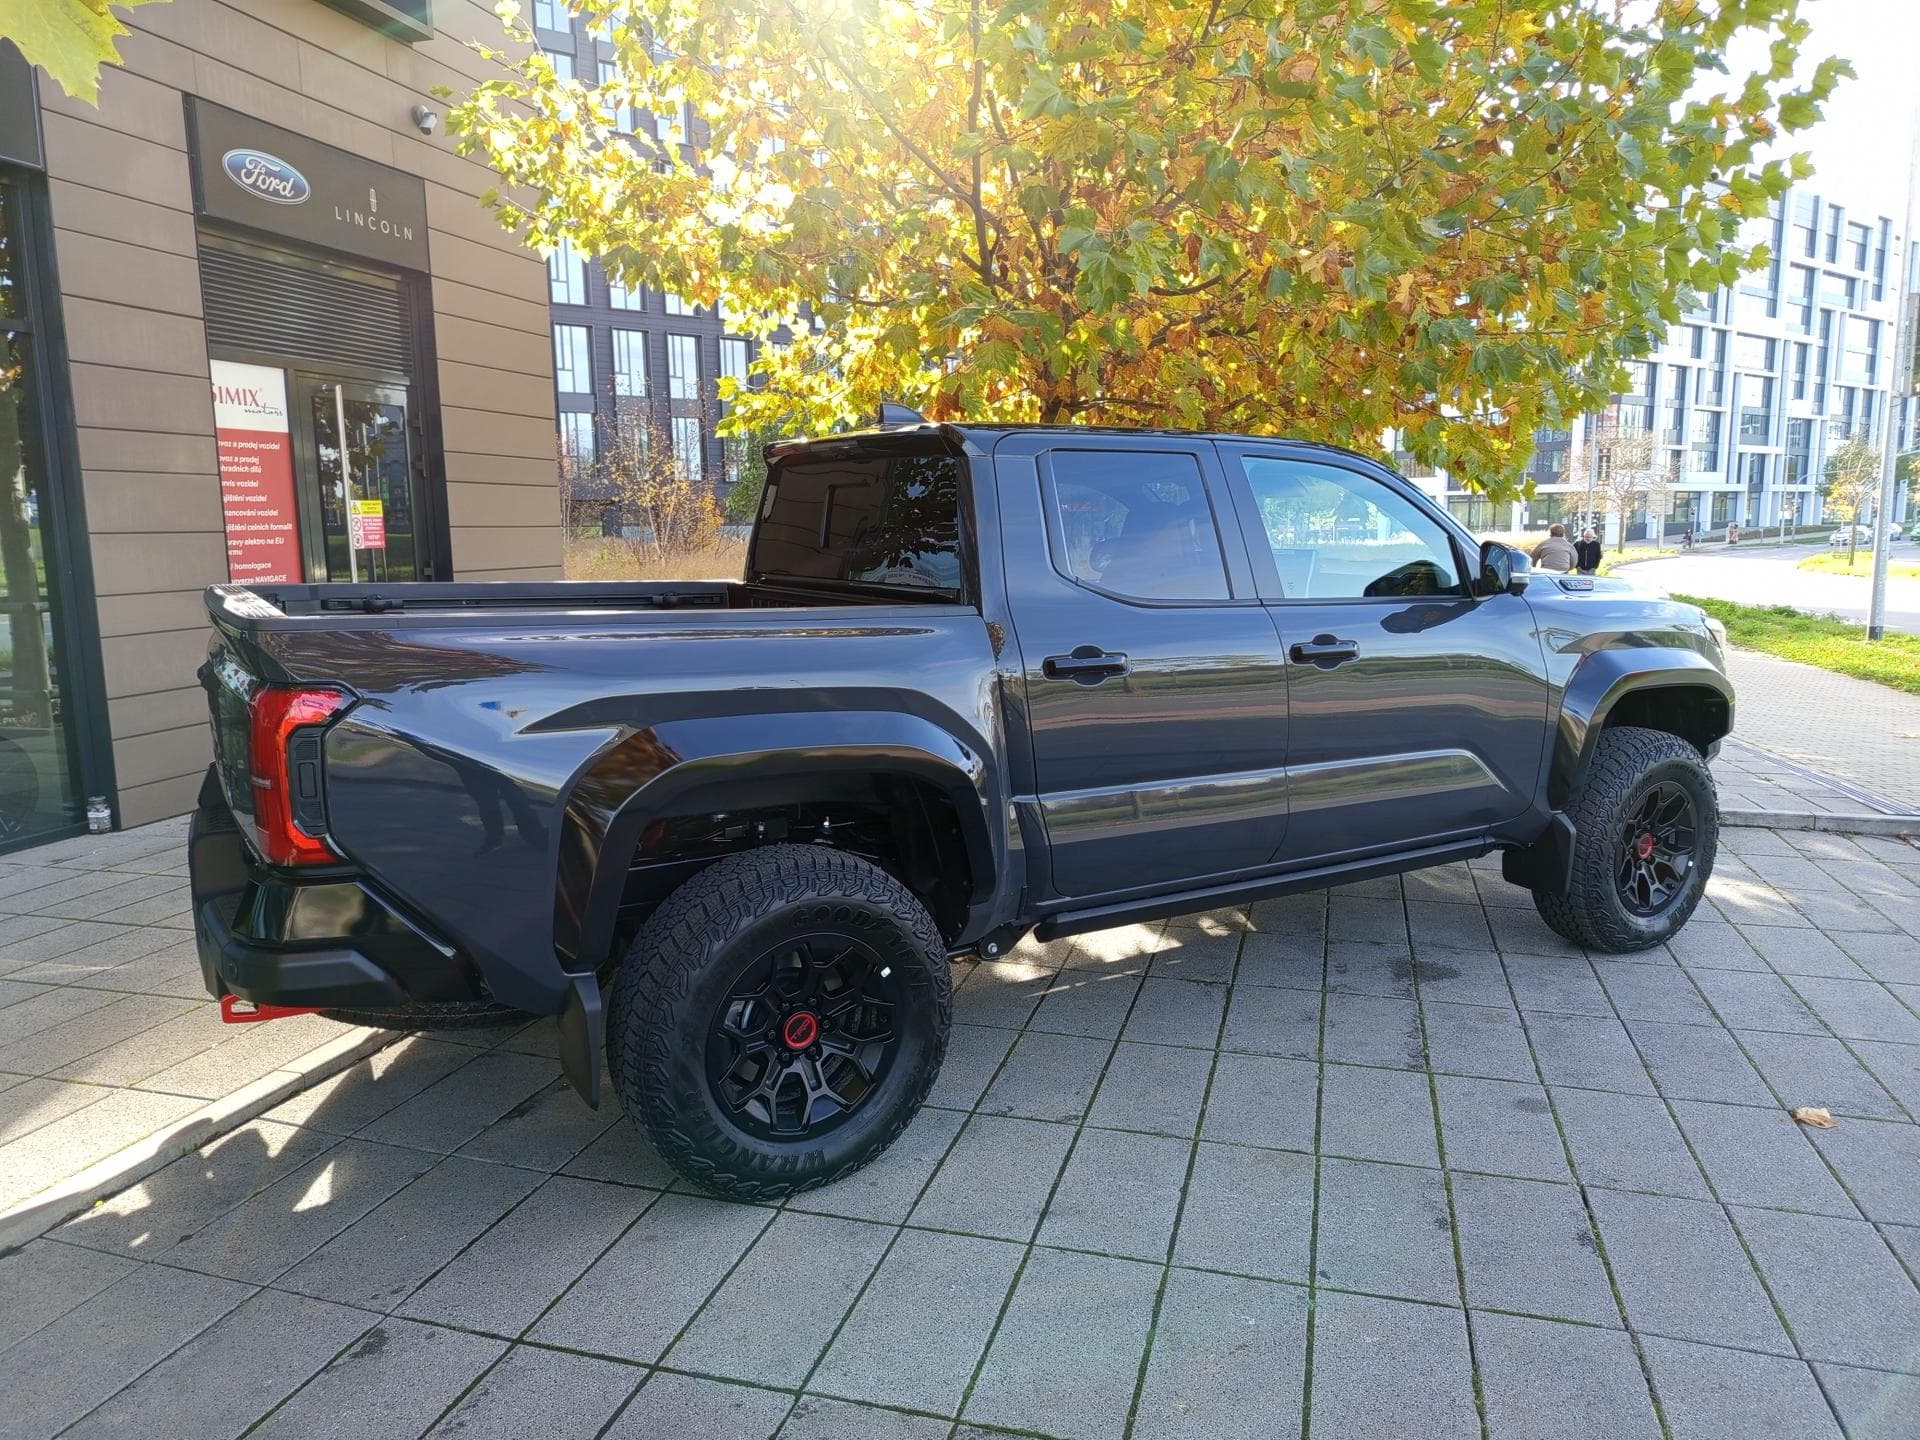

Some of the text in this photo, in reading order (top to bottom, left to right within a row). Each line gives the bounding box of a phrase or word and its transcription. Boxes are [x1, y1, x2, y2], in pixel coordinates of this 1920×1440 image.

[241, 156, 295, 197] Ford
[334, 206, 413, 241] LINCOLN
[238, 440, 258, 450] prodej
[259, 442, 280, 450] vozidel
[239, 455, 260, 465] prodej
[220, 465, 249, 473] hradních
[222, 494, 268, 503] jištění vozidel
[224, 508, 256, 516] nancování
[244, 537, 266, 545] elektro
[234, 562, 272, 570] homologace
[255, 574, 288, 583] NAVIGACE
